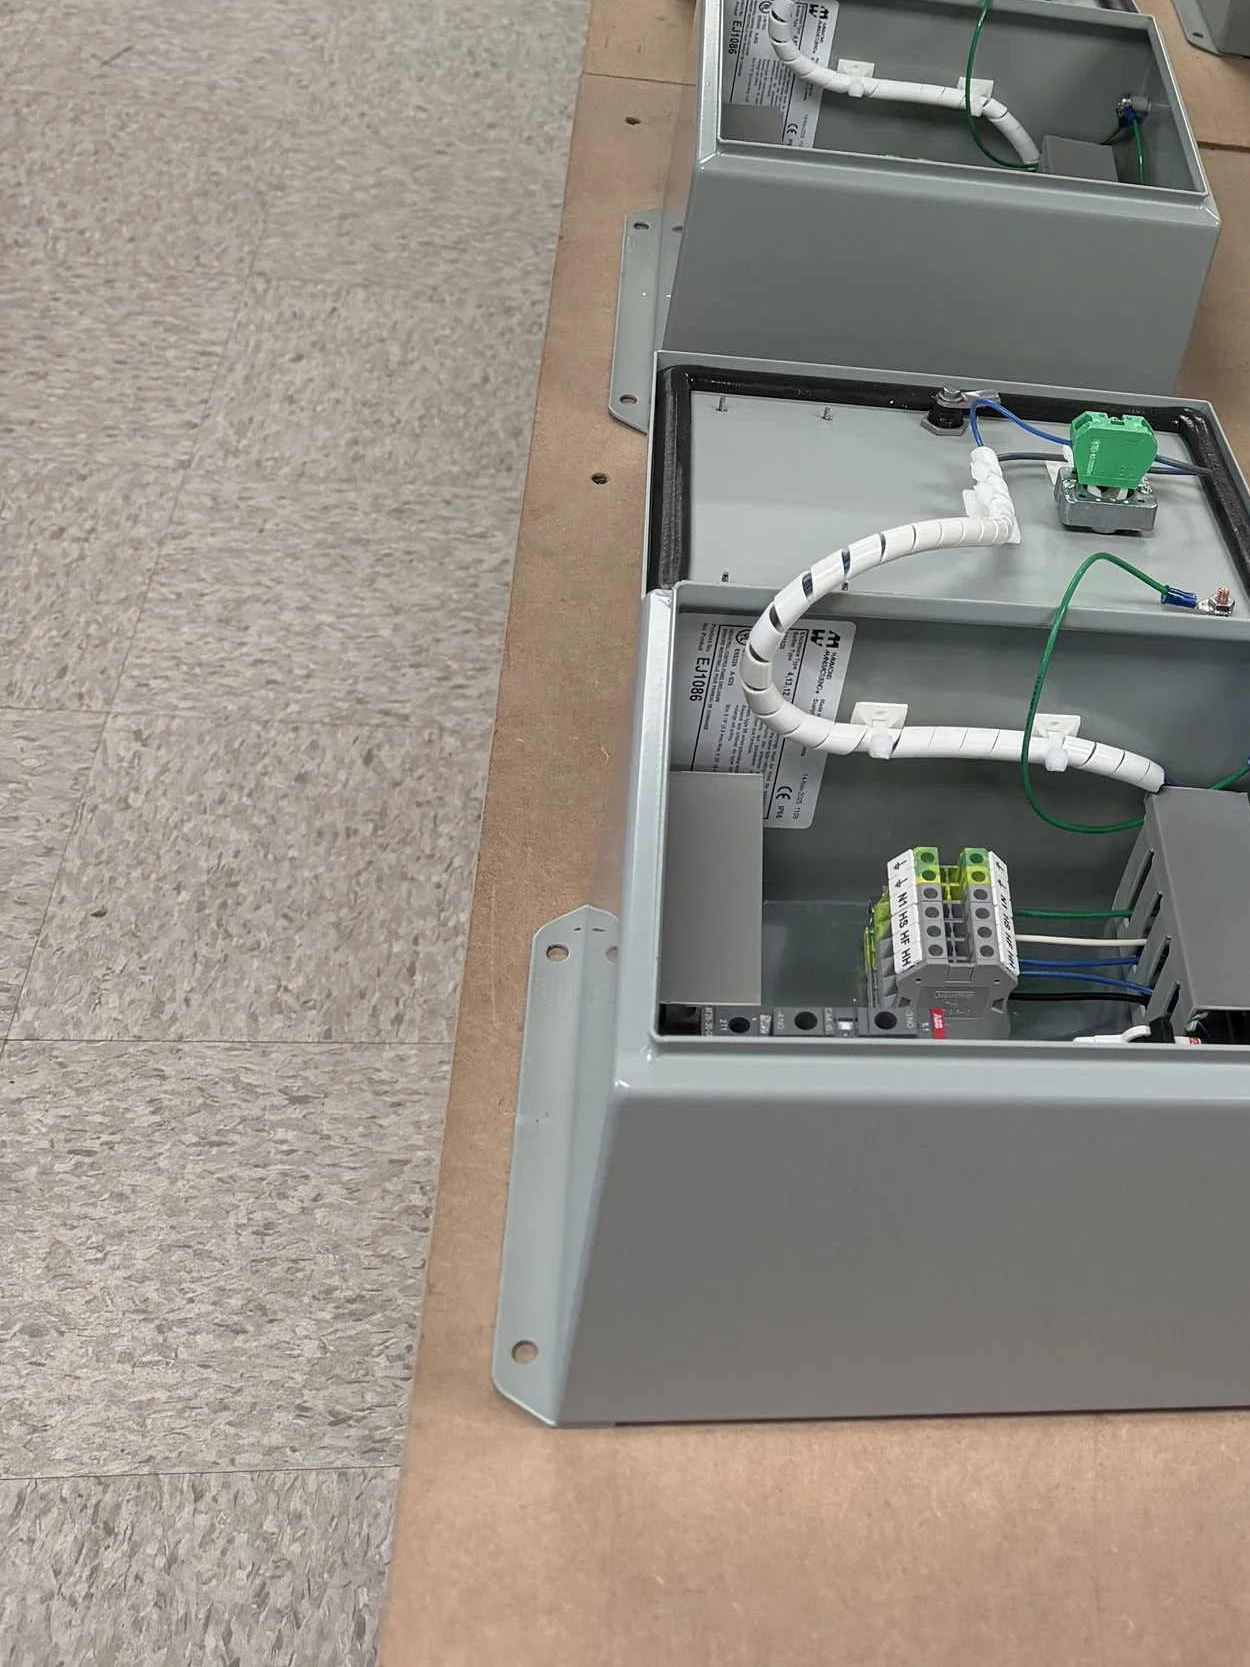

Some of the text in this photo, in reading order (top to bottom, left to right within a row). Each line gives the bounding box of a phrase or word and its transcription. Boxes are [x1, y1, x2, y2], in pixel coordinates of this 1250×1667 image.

[728, 19, 743, 55] EJ1086
[689, 657, 711, 702] EJ1086
[775, 786, 792, 800] CE
[898, 891, 912, 967] N1 HS HF HH
[1000, 896, 1016, 970] N1 HS HF HH
[933, 1013, 944, 1029] ABB
